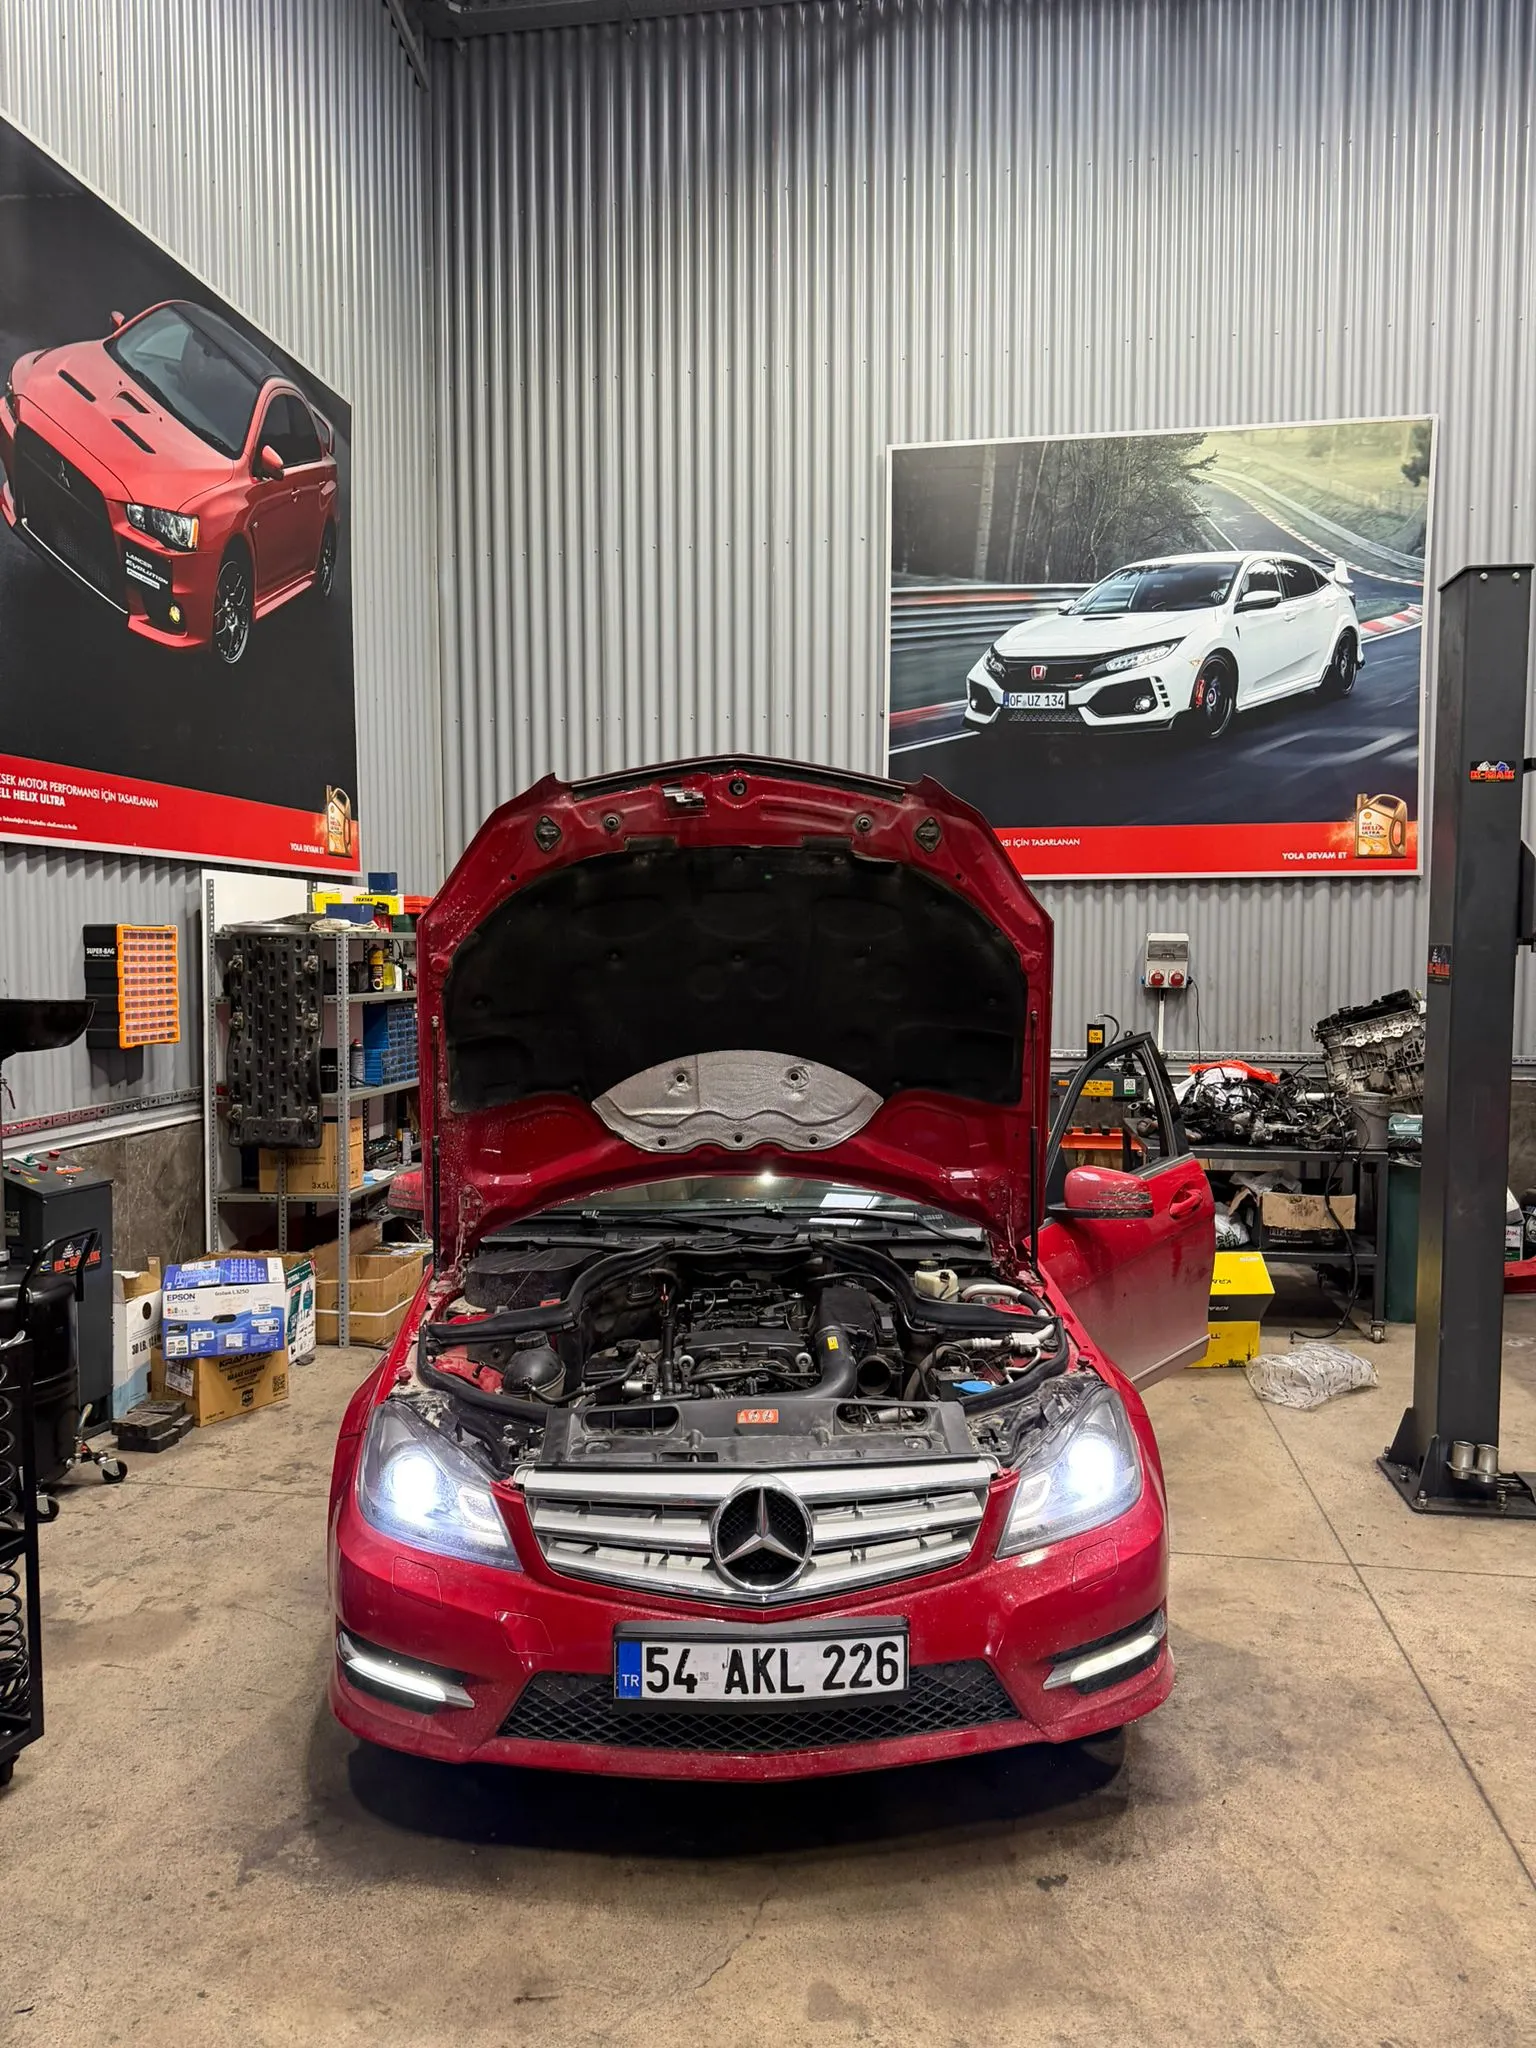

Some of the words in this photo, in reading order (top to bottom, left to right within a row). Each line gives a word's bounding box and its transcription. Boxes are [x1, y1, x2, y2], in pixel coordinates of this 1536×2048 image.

[126, 552, 152, 569] LANCER
[125, 559, 168, 584] EVOLUTION
[1010, 694, 1021, 706] OF
[1028, 694, 1040, 706] UZ
[1044, 694, 1064, 707] 134
[13, 789, 38, 803] HELIX
[40, 794, 66, 807] ULTRA
[18, 777, 48, 791] MOTOR
[50, 782, 100, 799] PERFORMANSI
[117, 792, 159, 808] TASARLANAN
[1013, 838, 1030, 848] İÇİN
[1032, 838, 1081, 846] TASARLANAN
[1282, 851, 1304, 860] YOLA
[1306, 851, 1335, 860] DEVAM
[1338, 851, 1348, 859] ET
[166, 1293, 196, 1302] EPSON
[646, 1647, 698, 1694] 54
[724, 1648, 805, 1695] AKL
[822, 1641, 899, 1690] 226
[622, 1674, 640, 1687] TR
